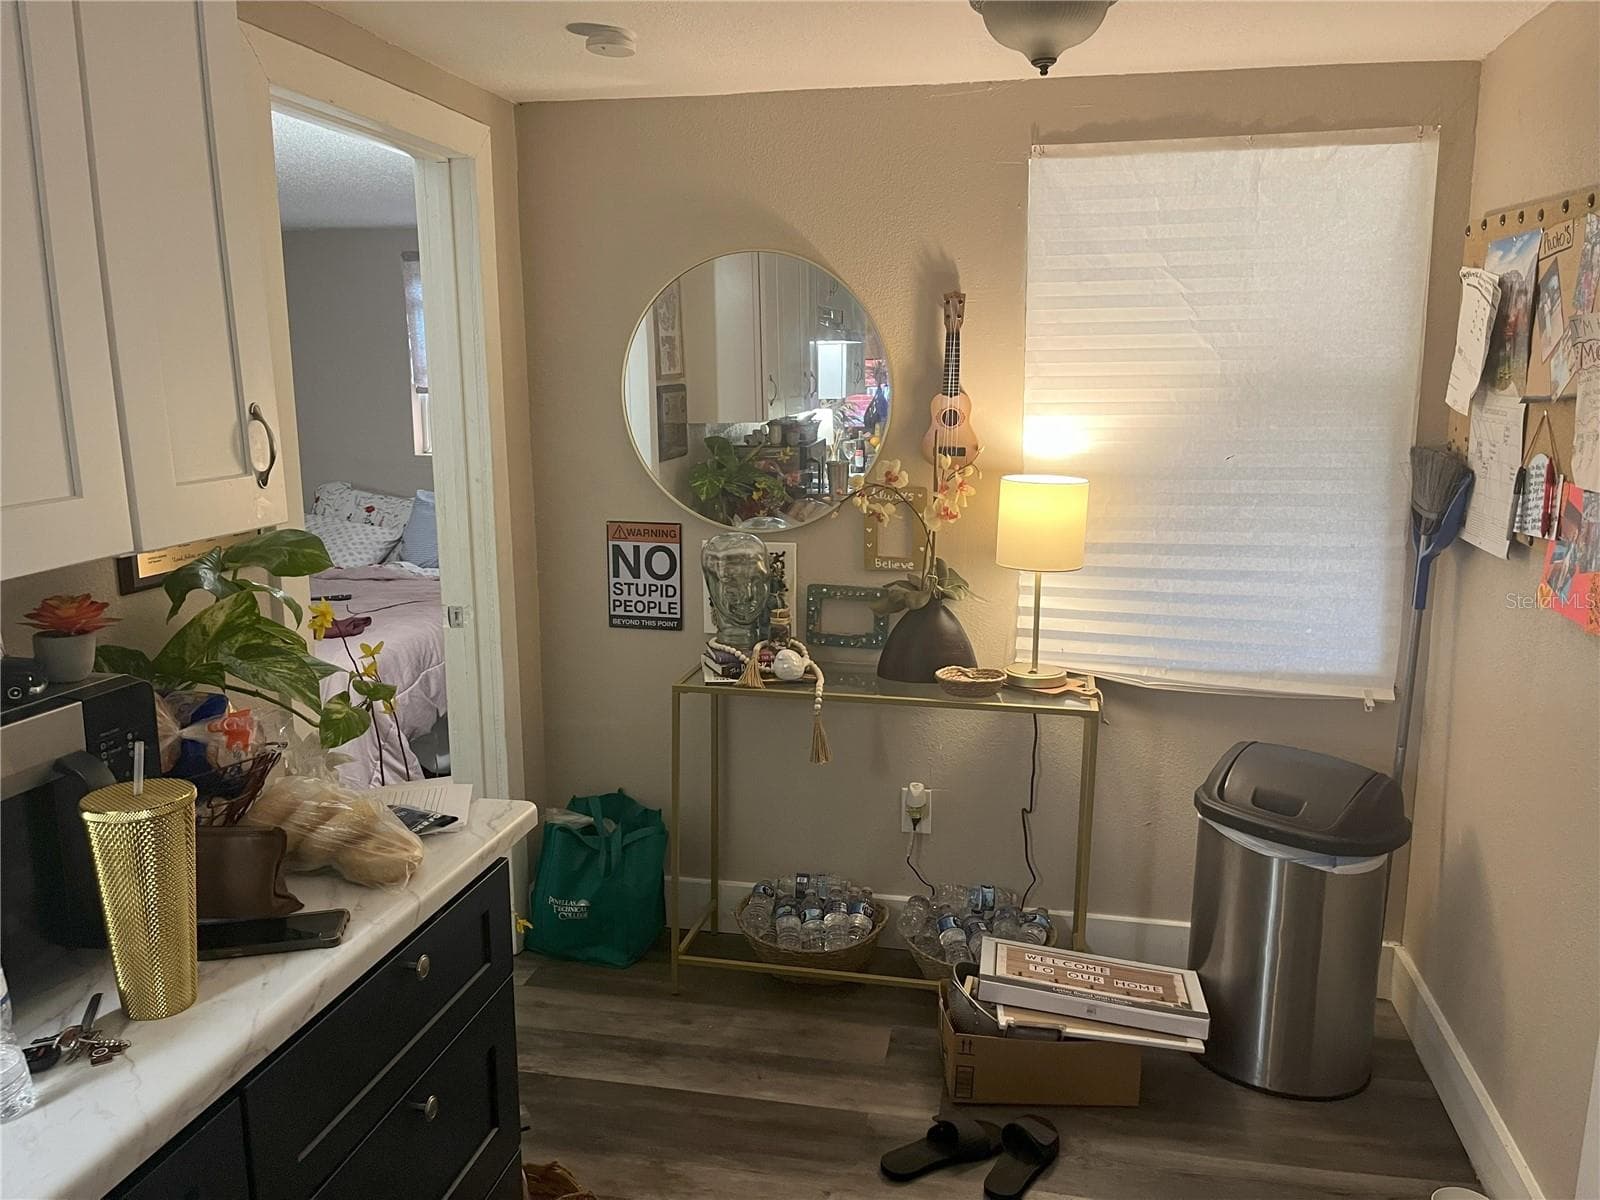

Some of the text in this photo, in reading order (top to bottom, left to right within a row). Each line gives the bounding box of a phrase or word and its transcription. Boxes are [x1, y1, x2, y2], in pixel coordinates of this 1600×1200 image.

[626, 528, 677, 539] WARNING
[612, 544, 678, 581] NO
[875, 558, 914, 570] Believe
[612, 582, 677, 598] STUPID
[612, 599, 678, 615] PEOPLE
[612, 618, 678, 628] BEYOND THIS POINT
[1026, 953, 1109, 974] WELCOME
[1032, 964, 1162, 993] TO OUR HOME
